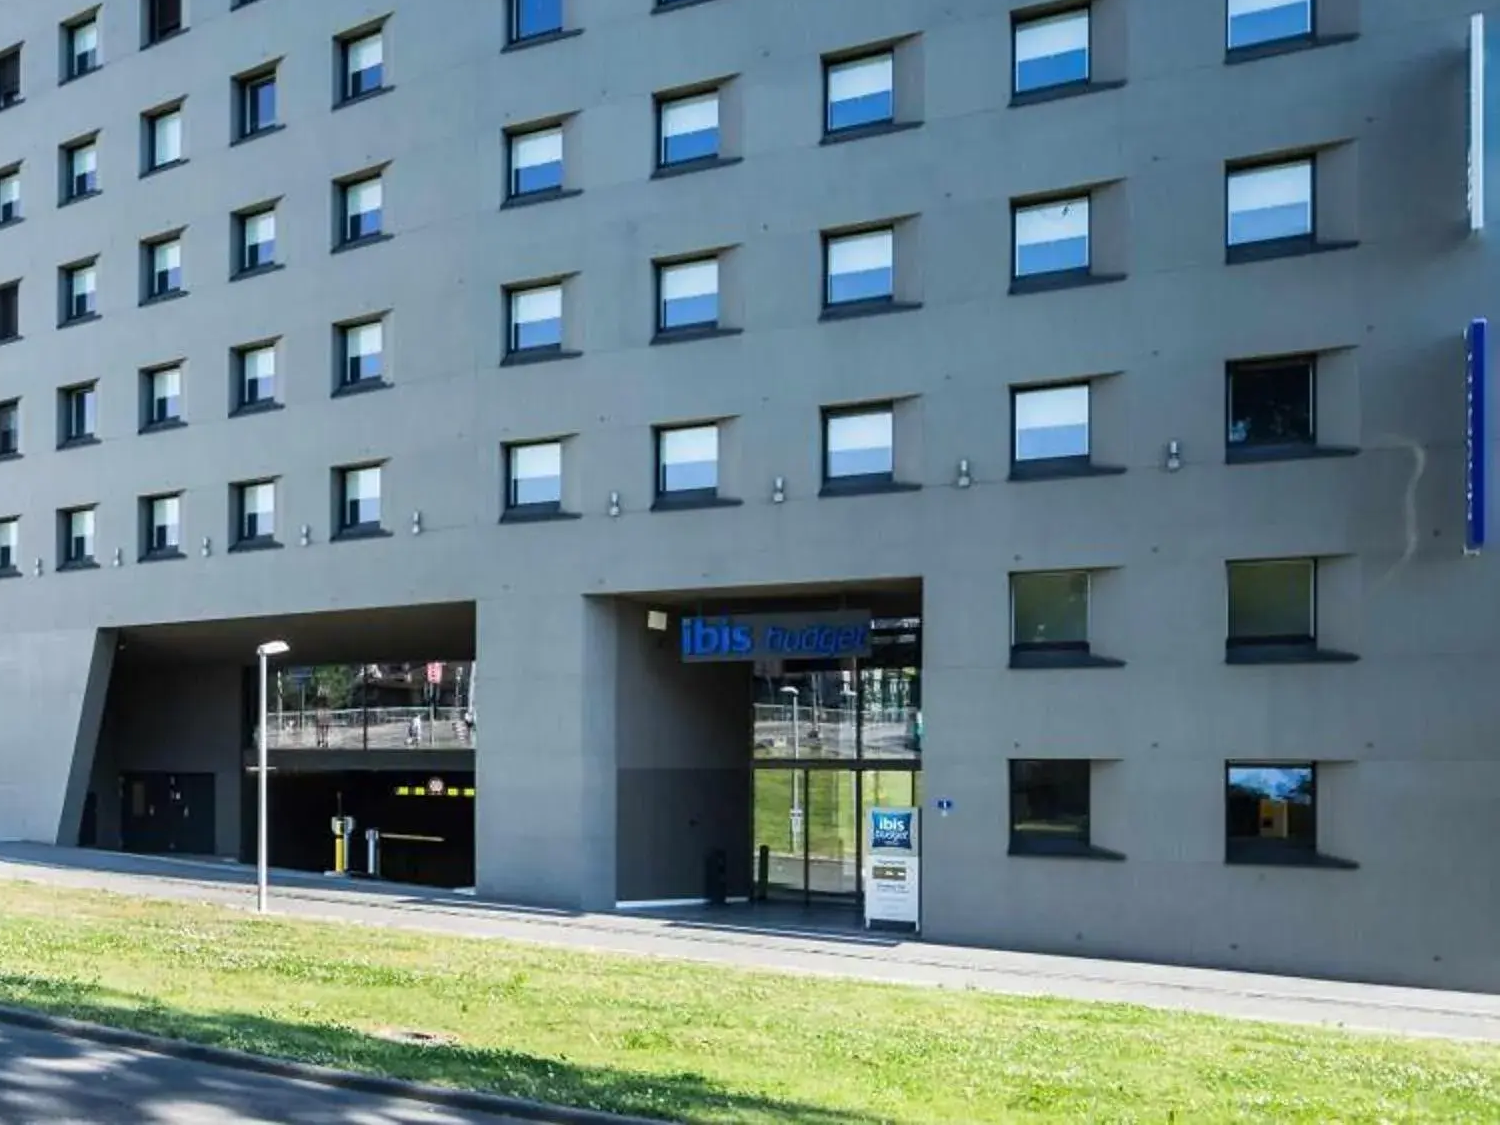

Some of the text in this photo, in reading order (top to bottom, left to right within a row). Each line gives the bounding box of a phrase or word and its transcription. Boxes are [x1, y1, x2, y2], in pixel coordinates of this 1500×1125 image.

[681, 617, 871, 656] ibis budget
[879, 817, 905, 832] ibis
